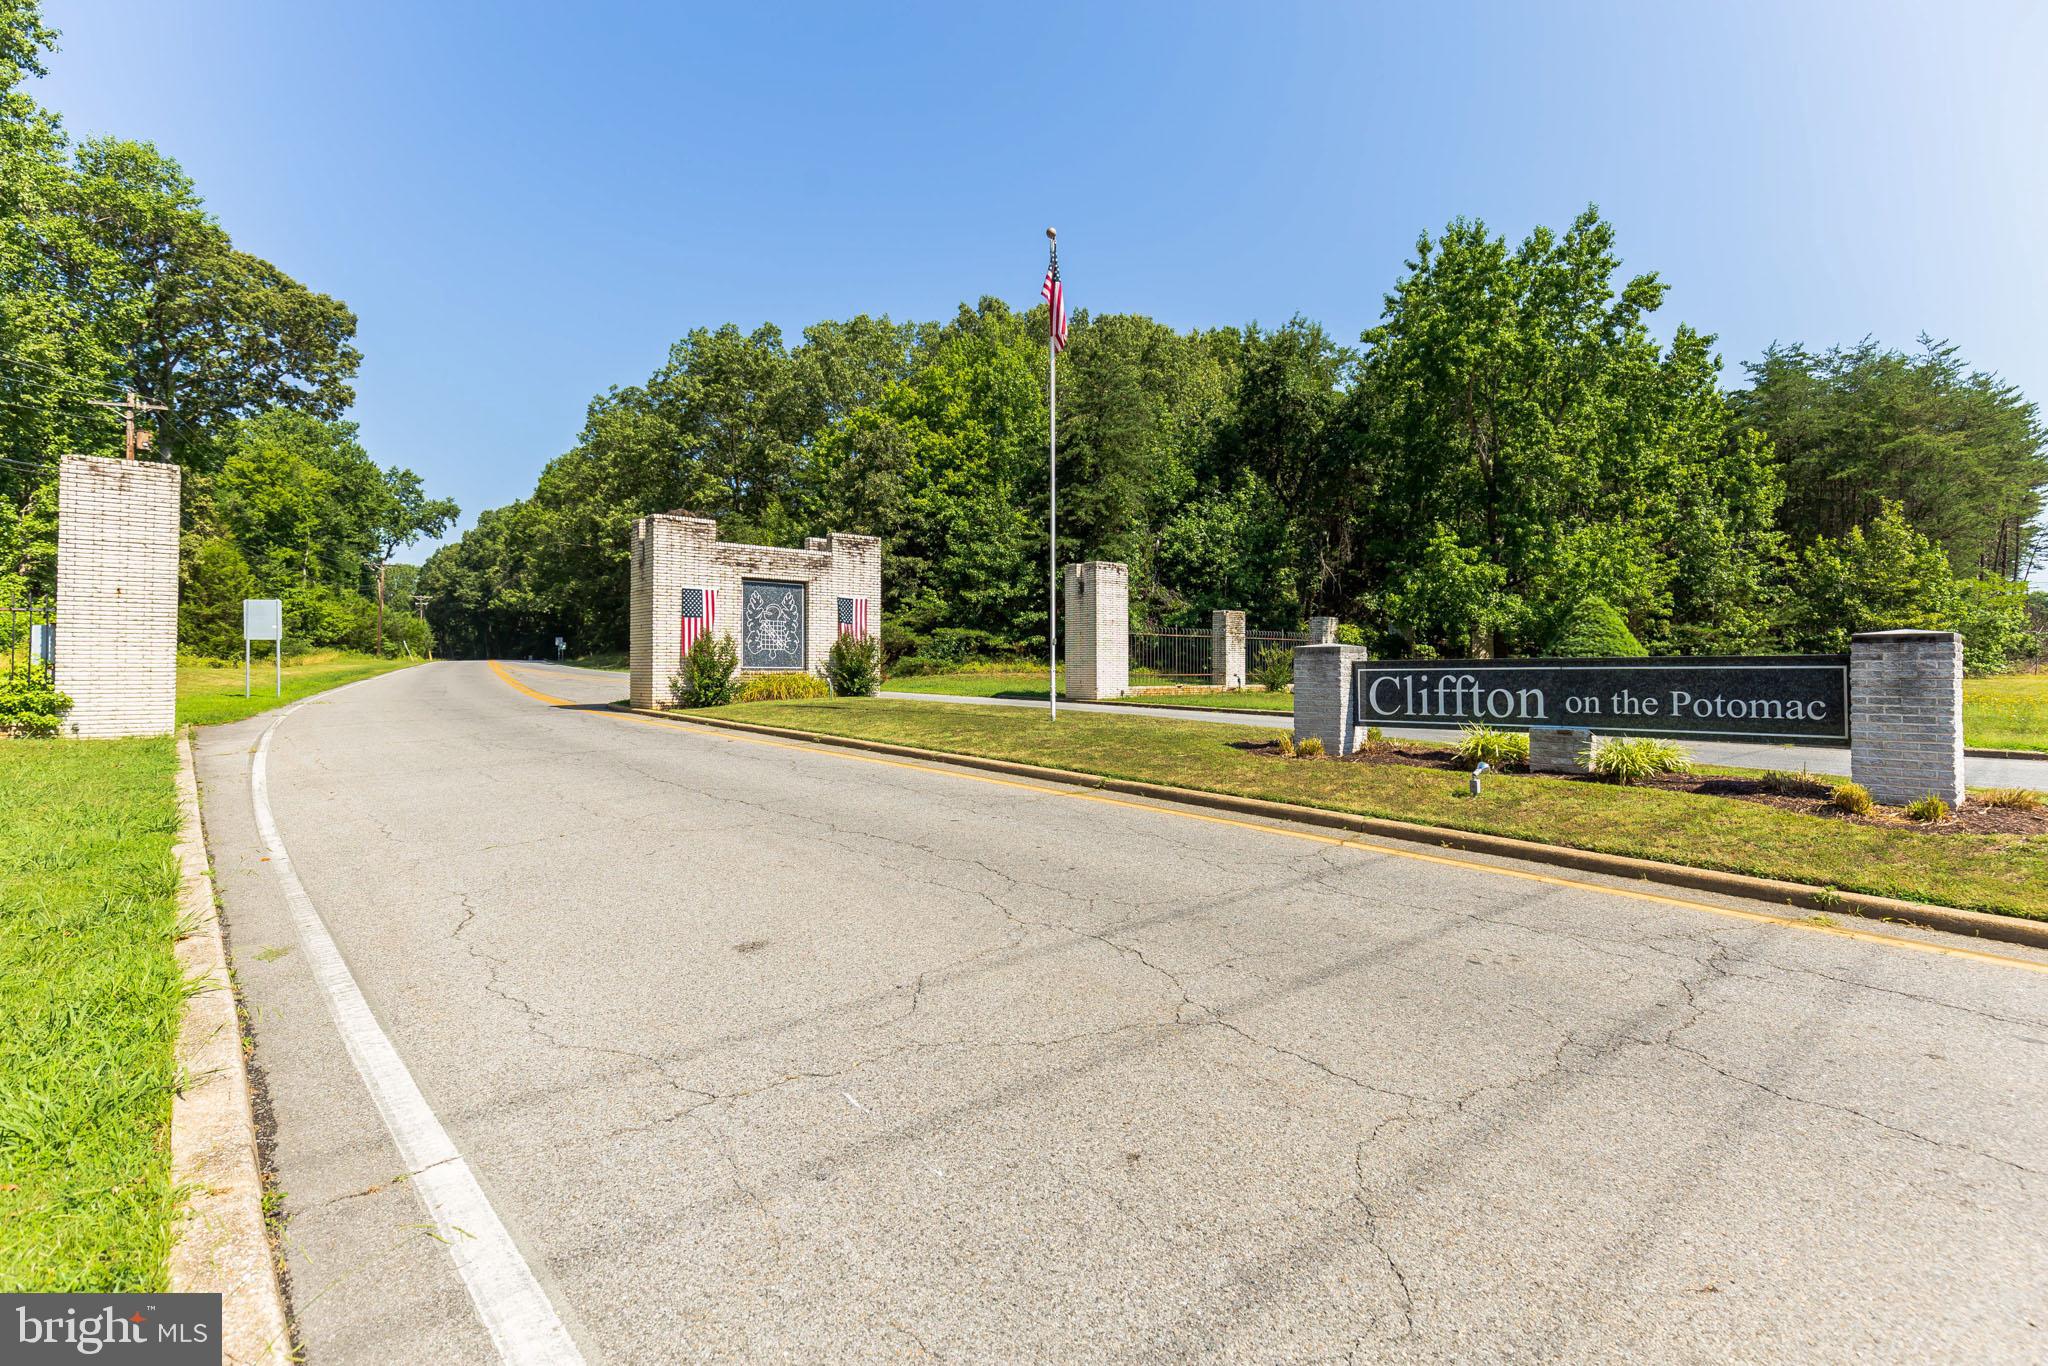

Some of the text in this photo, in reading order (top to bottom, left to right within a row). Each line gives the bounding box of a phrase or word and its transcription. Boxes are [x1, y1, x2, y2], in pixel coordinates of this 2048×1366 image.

[1369, 674, 1827, 721] Cliffton on the Potomac
